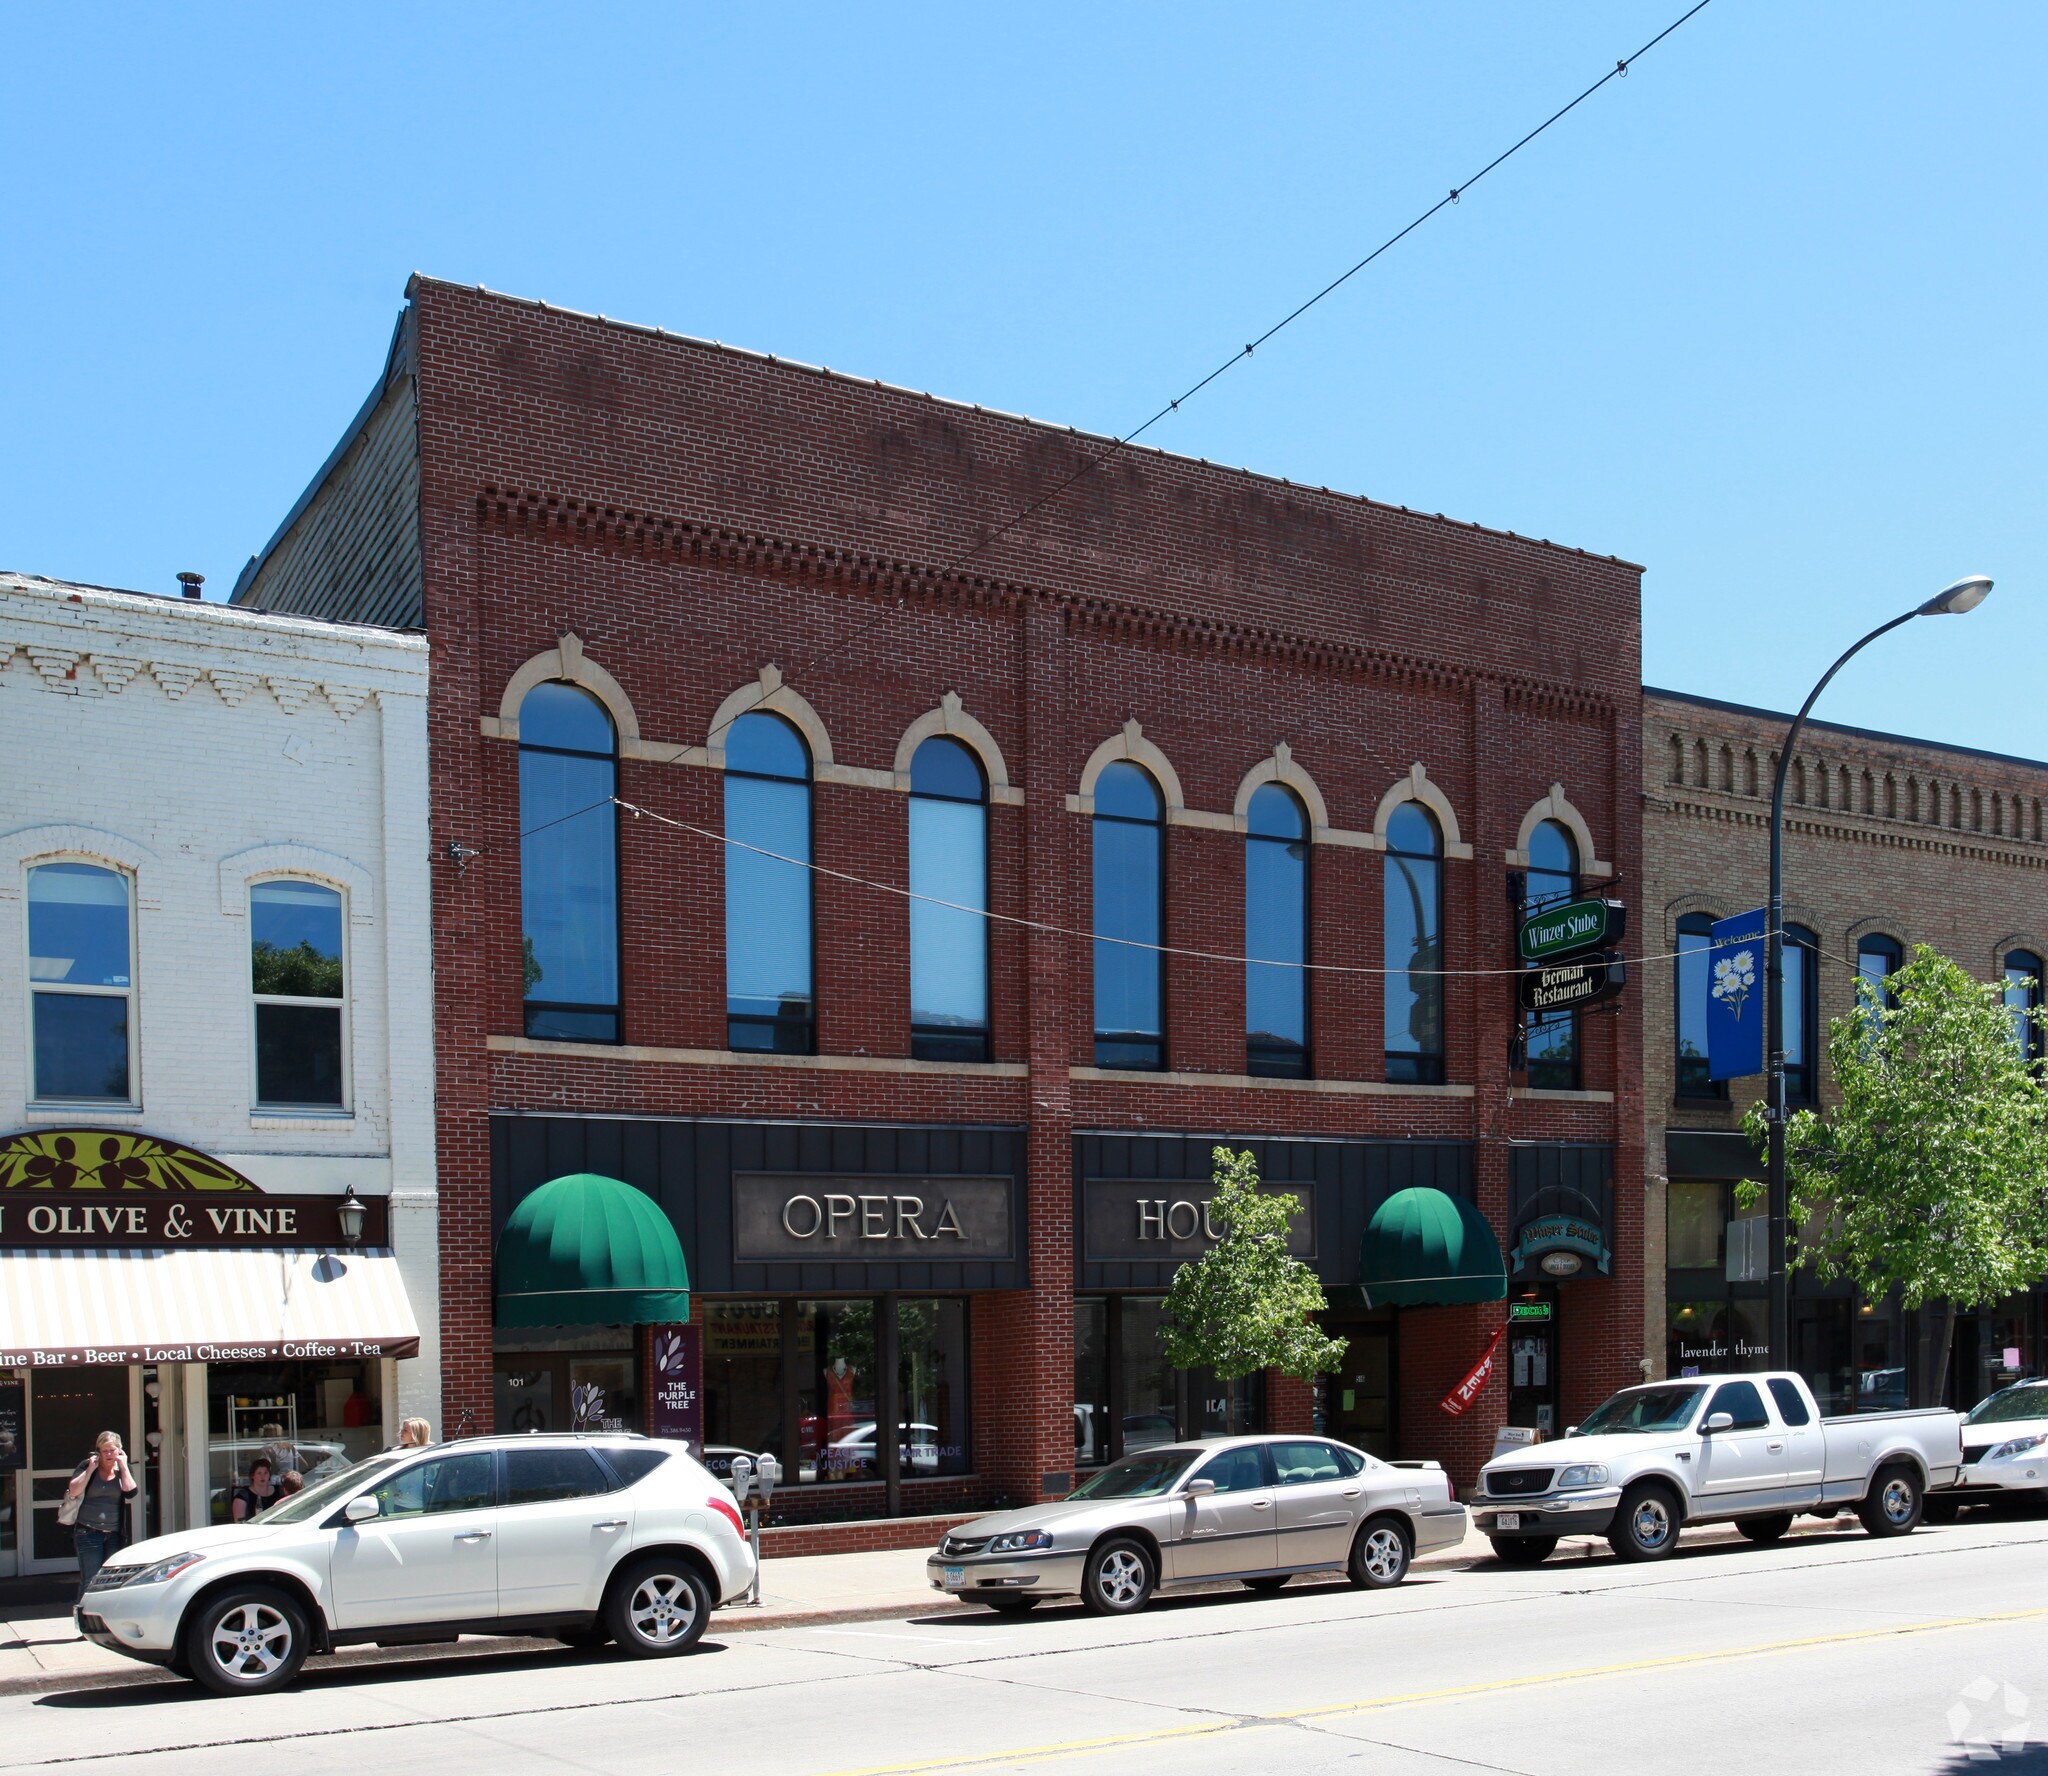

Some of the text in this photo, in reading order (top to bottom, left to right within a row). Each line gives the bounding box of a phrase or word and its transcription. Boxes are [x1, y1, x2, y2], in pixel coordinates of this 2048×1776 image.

[1528, 913, 1600, 949] Winzer Stube
[1715, 930, 1761, 947] Welcome
[1541, 965, 1584, 987] German
[1533, 976, 1593, 1007] Restaurant
[27, 1205, 148, 1234] OLIVE
[163, 1203, 193, 1239] &
[205, 1207, 298, 1235] VINE
[782, 1194, 1271, 1241] OPERA HOU
[0, 1341, 381, 1366] ine Bar Beer Local Cheeses Coffee Tea
[1681, 1338, 1769, 1358] lavender thyme
[508, 1378, 524, 1387] 101
[667, 1382, 687, 1391] THE
[658, 1390, 696, 1401] PURPLE
[665, 1400, 689, 1410] TREE
[600, 1418, 623, 1429] THE
[820, 1447, 857, 1458] PEACE
[900, 1446, 962, 1458] FAIR TRADE
[822, 1457, 868, 1470] JUSTICE
